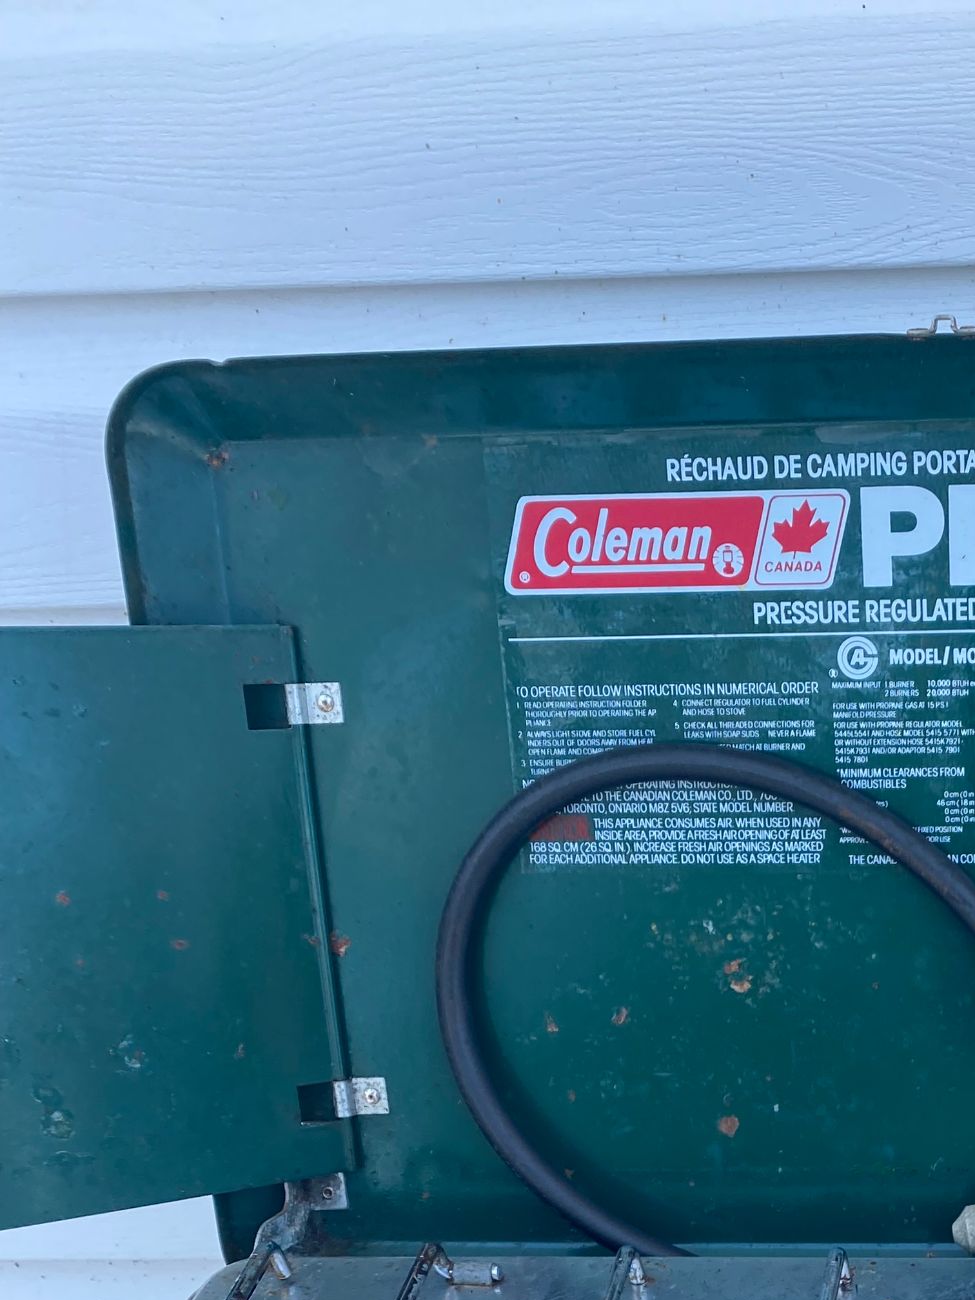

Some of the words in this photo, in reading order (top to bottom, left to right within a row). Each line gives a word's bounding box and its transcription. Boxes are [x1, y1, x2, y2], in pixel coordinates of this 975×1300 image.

[667, 453, 768, 481] RÉCHAUD
[774, 455, 801, 478] DE
[807, 452, 907, 478] CAMPING
[533, 506, 712, 577] Coleman
[764, 560, 822, 573] CANADA
[753, 600, 860, 625] PRESSURE
[516, 686, 529, 698] TO
[531, 685, 576, 697] OPERATE
[578, 685, 621, 697] FOLLOW
[624, 684, 701, 697] INSTRUCTIONS
[704, 683, 715, 695] IN
[717, 682, 779, 695] NUMERICAL
[781, 682, 819, 694] ORDER
[883, 767, 938, 778] CLEARANCES
[940, 767, 965, 777] FROM
[605, 791, 621, 801] THE
[623, 790, 670, 800] CANADIAN
[671, 790, 716, 800] COLEMAN
[610, 802, 648, 813] ONTARIO
[650, 802, 670, 813] M8Z
[693, 802, 718, 813] STATE
[719, 802, 752, 813] MODEL
[593, 818, 614, 829] THIS
[615, 818, 662, 828] APPLIANCE
[665, 818, 716, 828] CONSUMES
[735, 818, 764, 828] WHEN
[765, 818, 790, 828] USED
[791, 817, 801, 828] IN
[802, 817, 821, 828] ANY
[594, 830, 624, 840] INSIDE
[649, 830, 686, 840] PROVIDE
[695, 830, 720, 840] FRESH
[722, 829, 737, 840] AIR
[738, 829, 778, 840] OPENING
[801, 829, 827, 840] LEAST
[530, 842, 547, 852] 168
[564, 842, 579, 852] CM
[634, 842, 677, 852] INCREASE
[678, 841, 706, 852] FRESH
[708, 841, 723, 852] AIR
[724, 841, 770, 852] OPENINGS
[771, 841, 783, 852] AS
[785, 841, 824, 851] MARKED
[530, 854, 547, 864] FOR
[549, 854, 574, 864] EACH
[575, 853, 628, 864] ADDITIONAL
[681, 853, 695, 864] DO
[697, 853, 715, 864] NOT
[717, 853, 734, 864] USE
[736, 853, 748, 863] AS
[749, 853, 757, 863] A
[757, 853, 785, 863] SPACE
[787, 853, 820, 863] HEATER
[849, 855, 865, 865] THE
